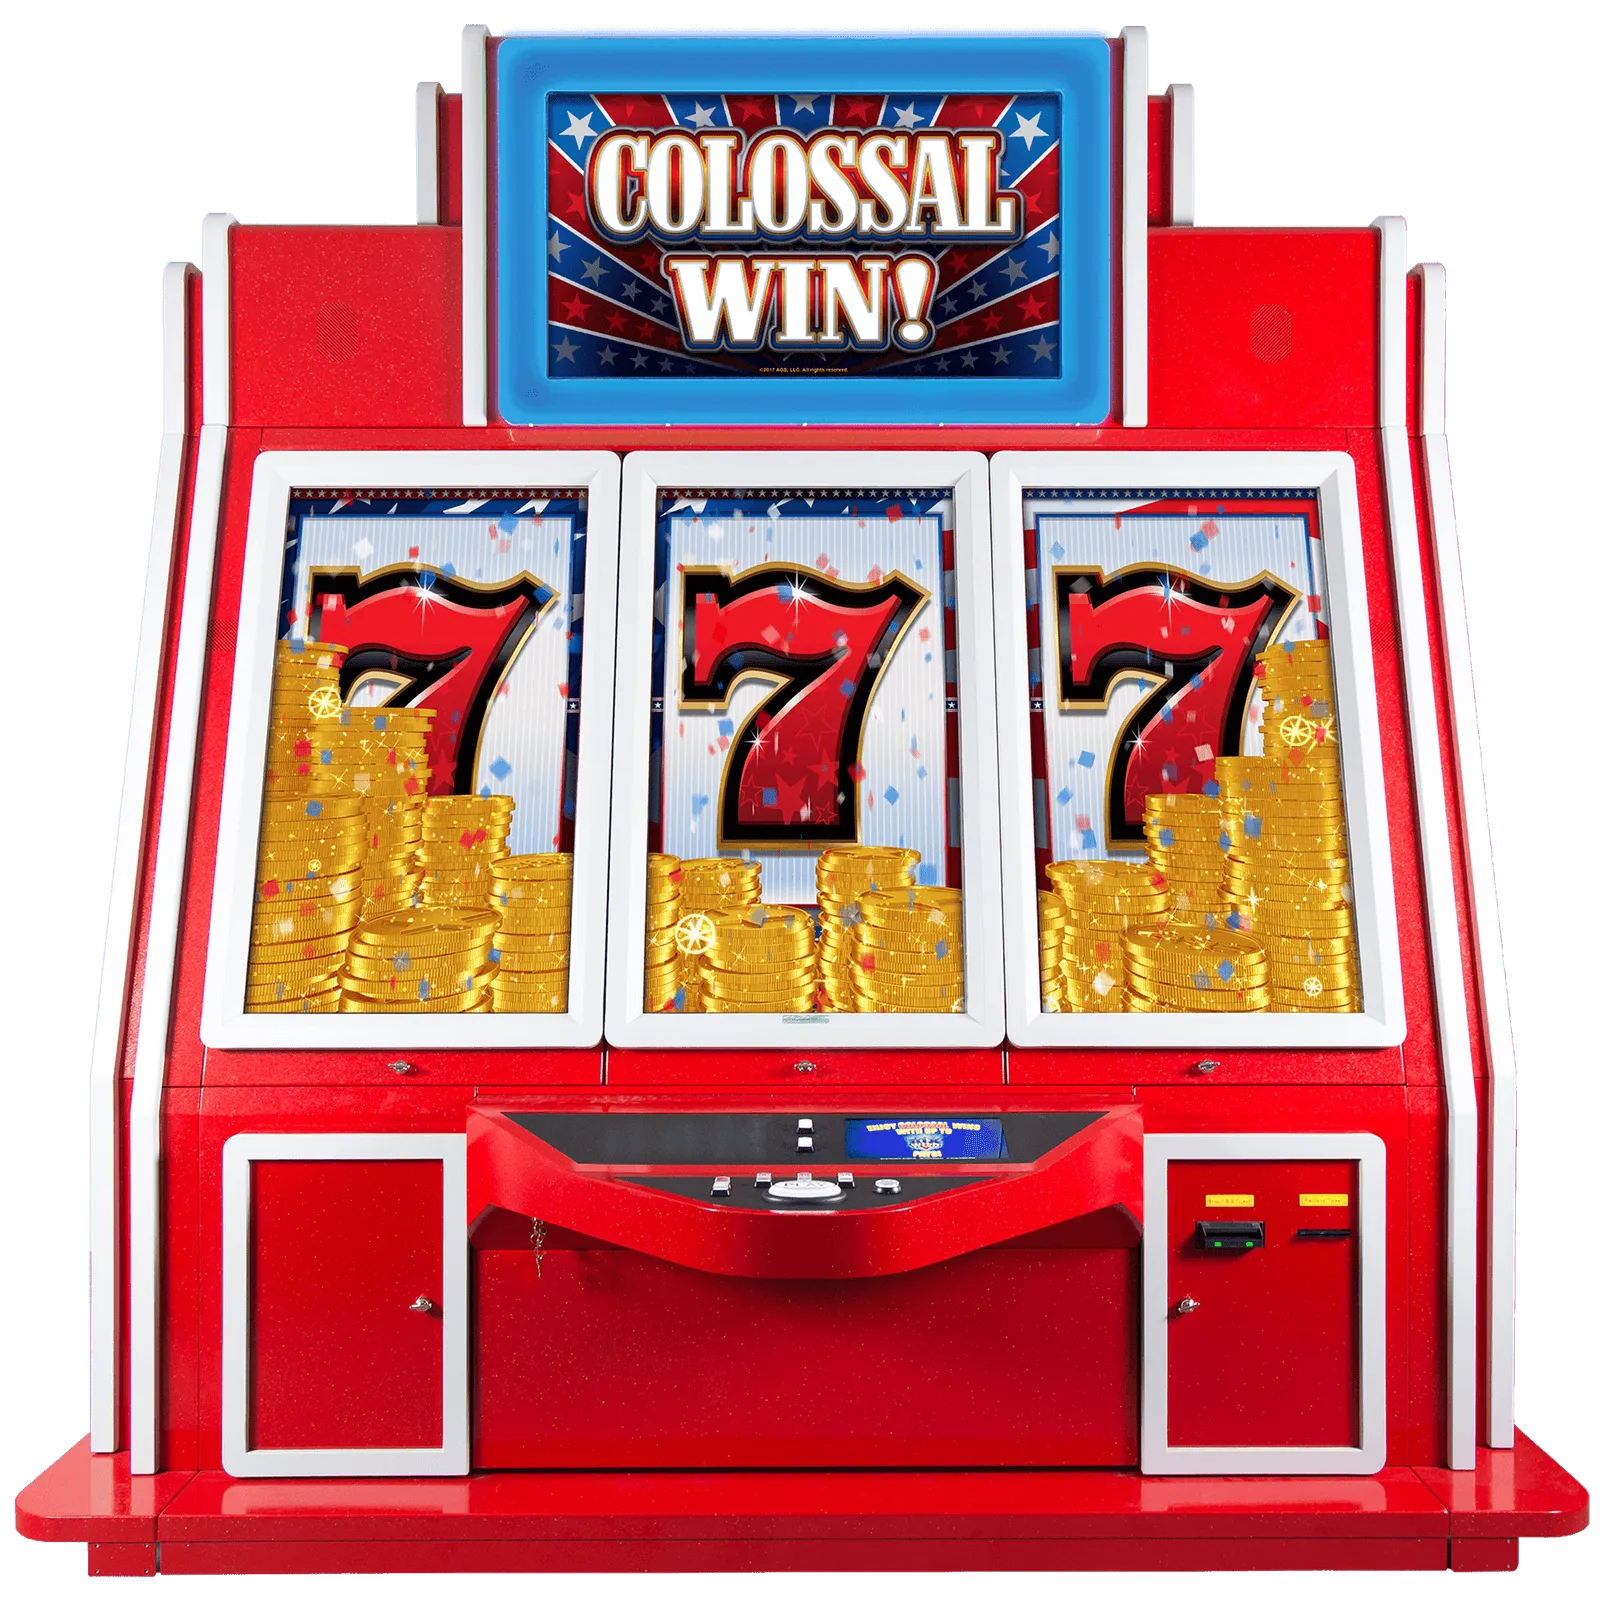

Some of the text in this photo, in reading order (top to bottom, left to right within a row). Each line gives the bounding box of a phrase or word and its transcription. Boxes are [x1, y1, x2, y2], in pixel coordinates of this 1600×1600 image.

[592, 132, 1018, 237] COLOSSAL
[667, 256, 932, 346] WIN!
[308, 562, 559, 797] 7
[678, 562, 932, 851] 7
[1052, 562, 1302, 851] 7
